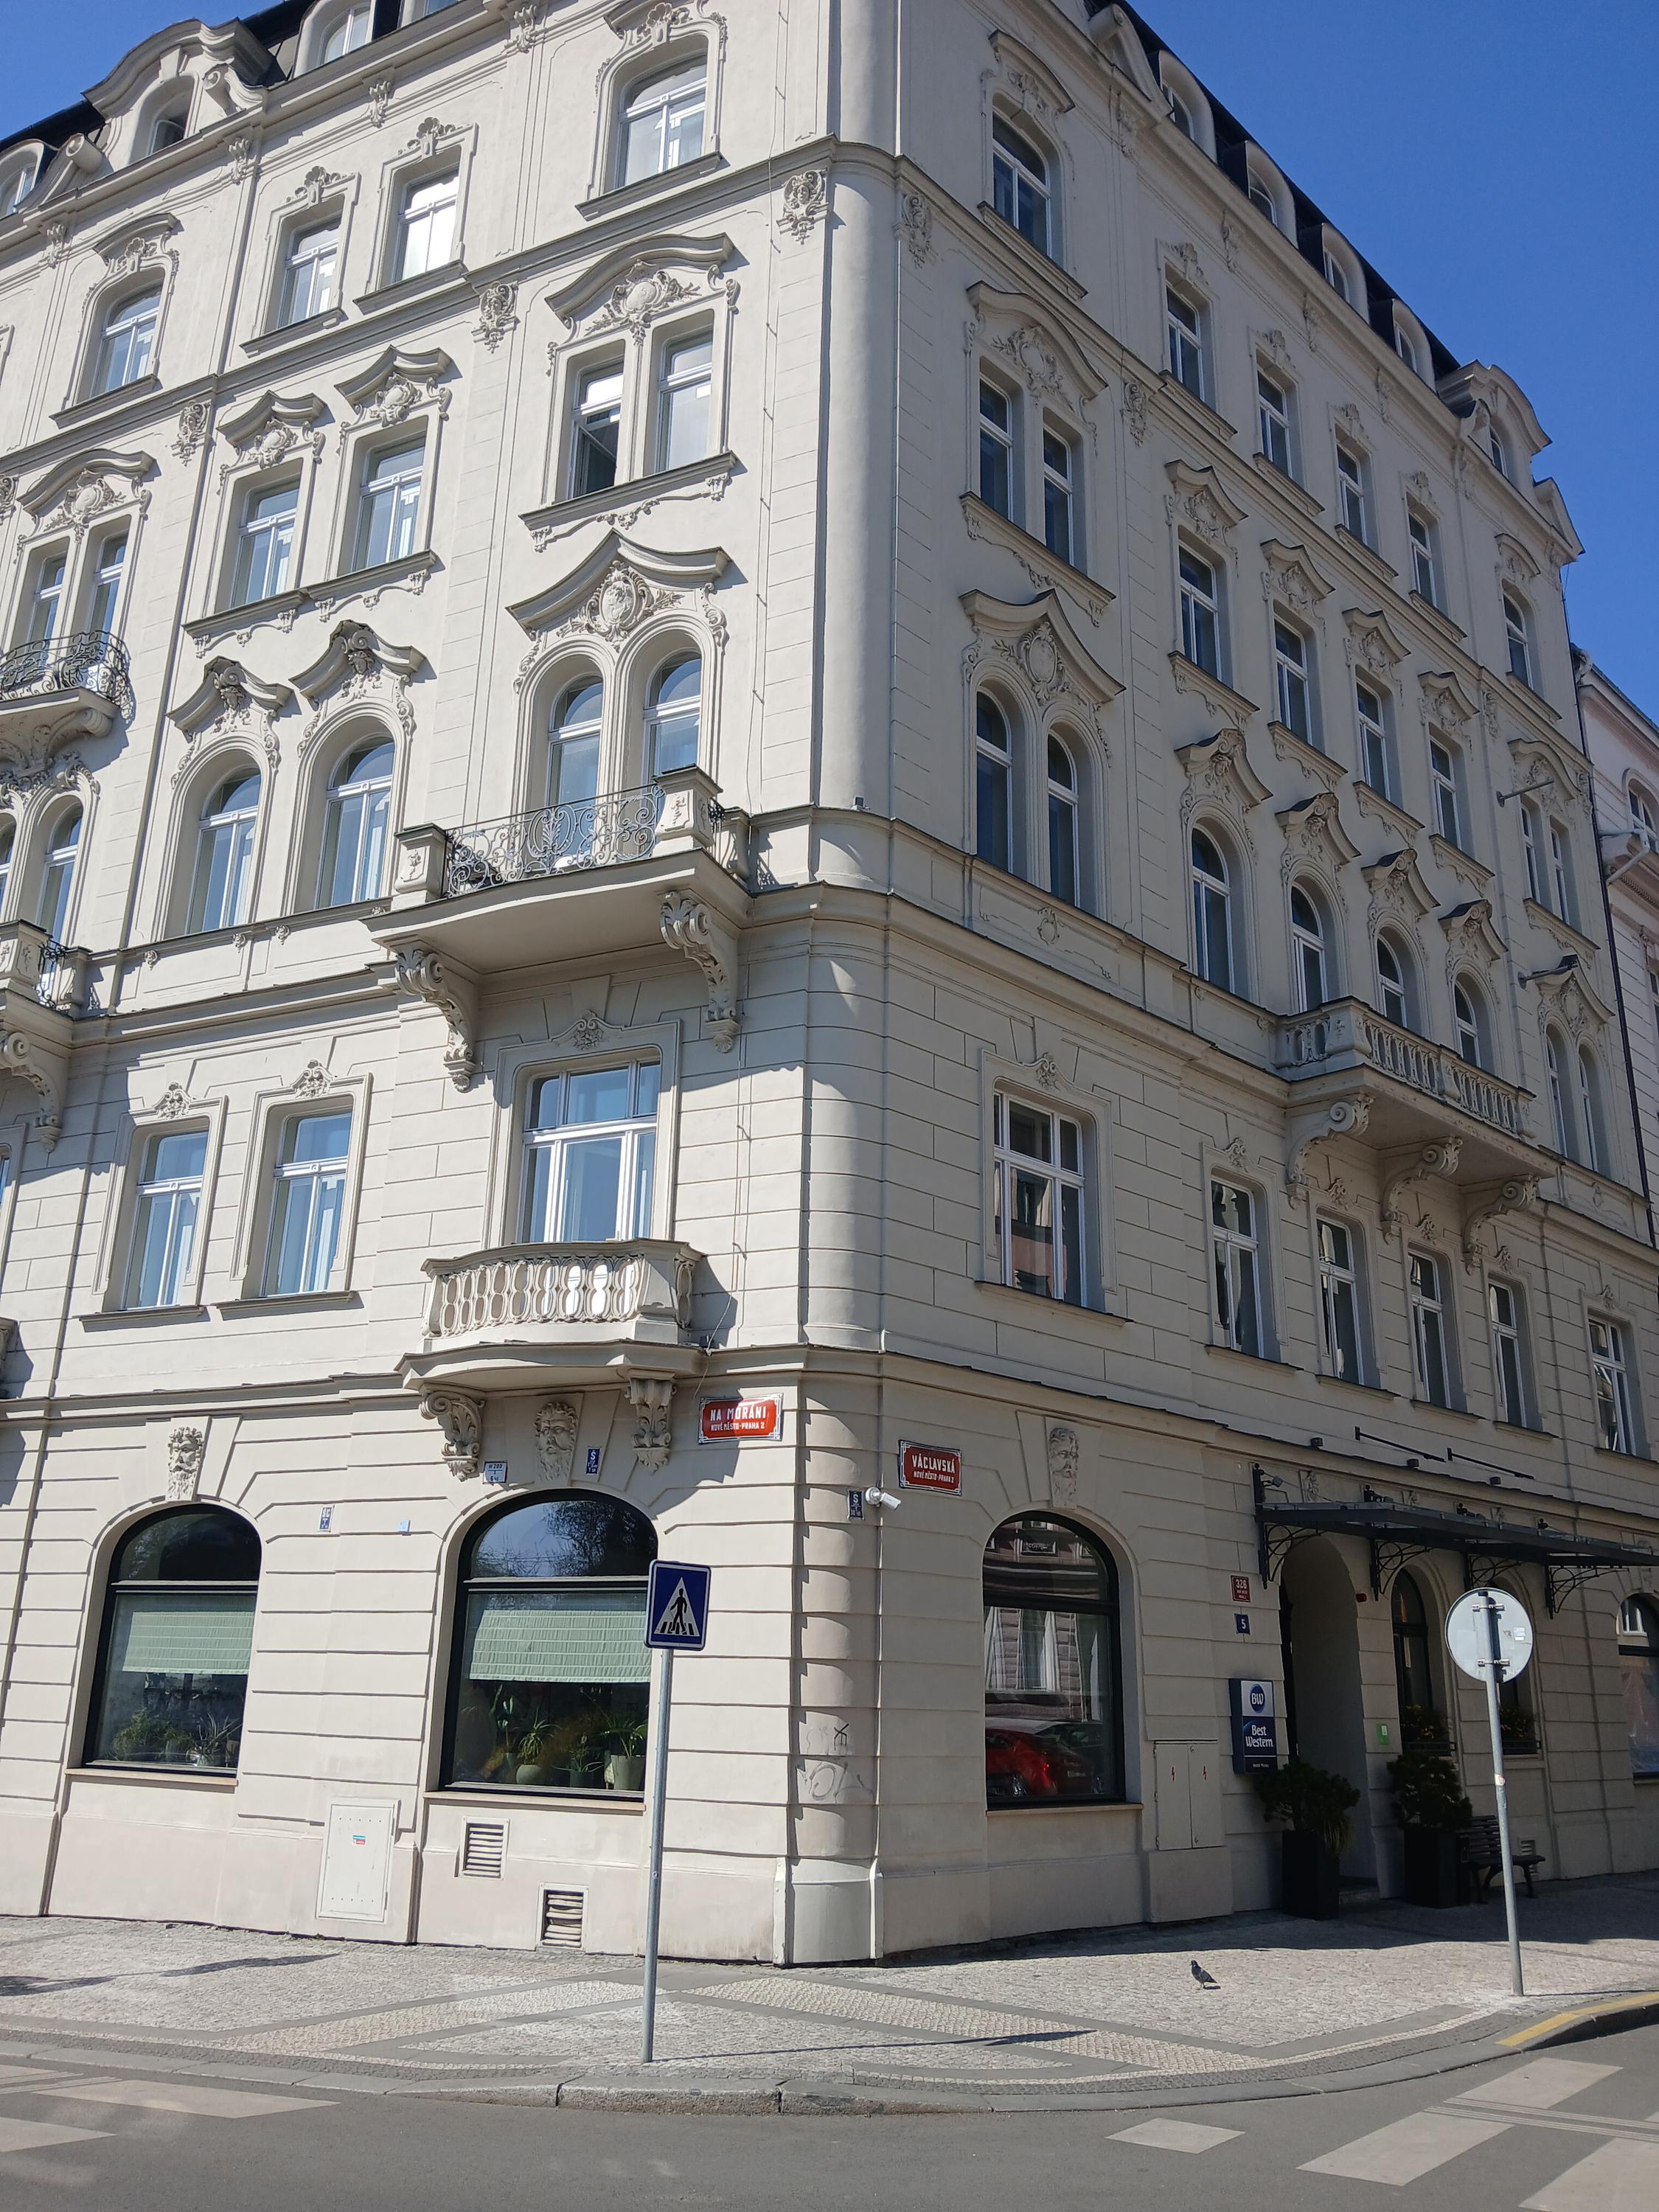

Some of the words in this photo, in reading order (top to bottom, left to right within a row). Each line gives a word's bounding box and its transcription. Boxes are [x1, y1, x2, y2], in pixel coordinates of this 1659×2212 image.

[710, 1409, 722, 1422] NA
[727, 1404, 767, 1420] MORÁNI
[711, 1422, 723, 1431] NOVÉ
[912, 1453, 956, 1474] VÁCLAVSKÁ
[914, 1470, 924, 1479] NOVÉ
[1236, 1579, 1247, 1589] 326
[1241, 1618, 1246, 1630] 5
[1251, 1692, 1264, 1705] BW
[1251, 1725, 1267, 1736] Best
[1245, 1736, 1273, 1747] Western
